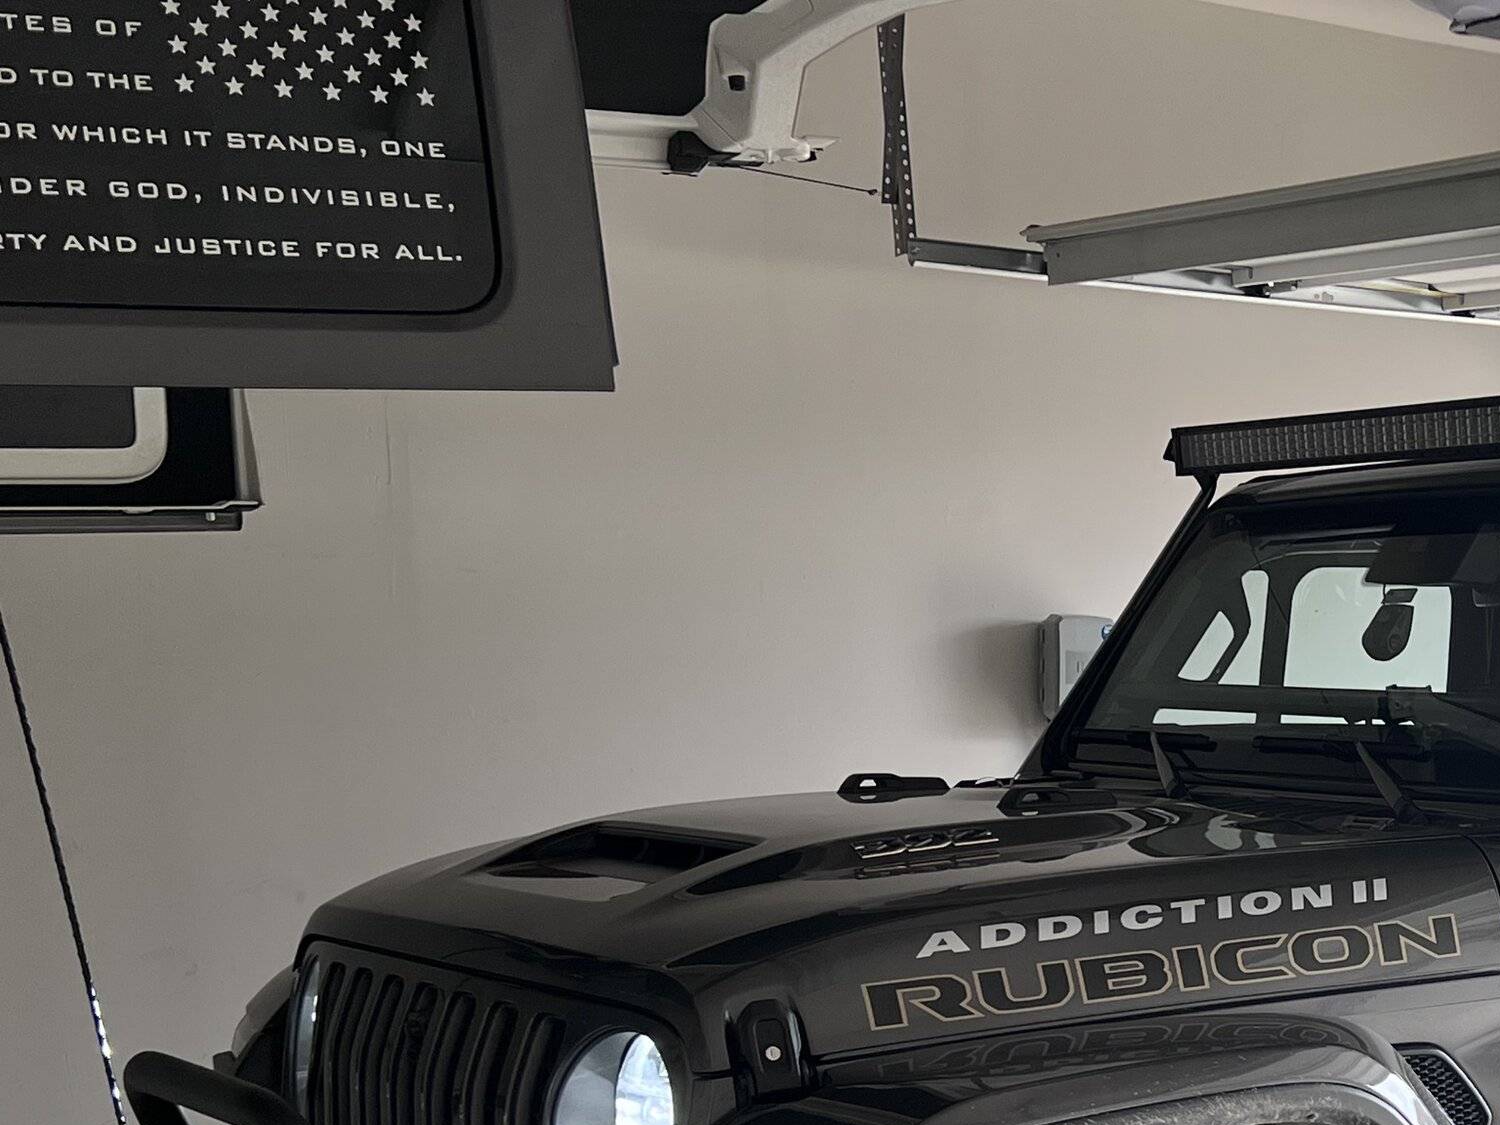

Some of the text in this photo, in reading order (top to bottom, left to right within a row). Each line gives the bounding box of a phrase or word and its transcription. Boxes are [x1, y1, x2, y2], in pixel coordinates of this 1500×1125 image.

[95, 19, 142, 37] OF
[29, 68, 74, 87] TO
[86, 71, 153, 91] THE
[51, 123, 168, 146] WHICH
[184, 130, 212, 147] IT
[226, 131, 367, 158] STANDS,
[380, 140, 446, 159] ONE
[0, 177, 456, 213] DER GOD, INDIVISIBLE,
[0, 233, 463, 262] TY AND JUSTICE FOR ALL.
[915, 877, 1388, 960] ADDICTION II
[861, 911, 1462, 1032] RUBICON
